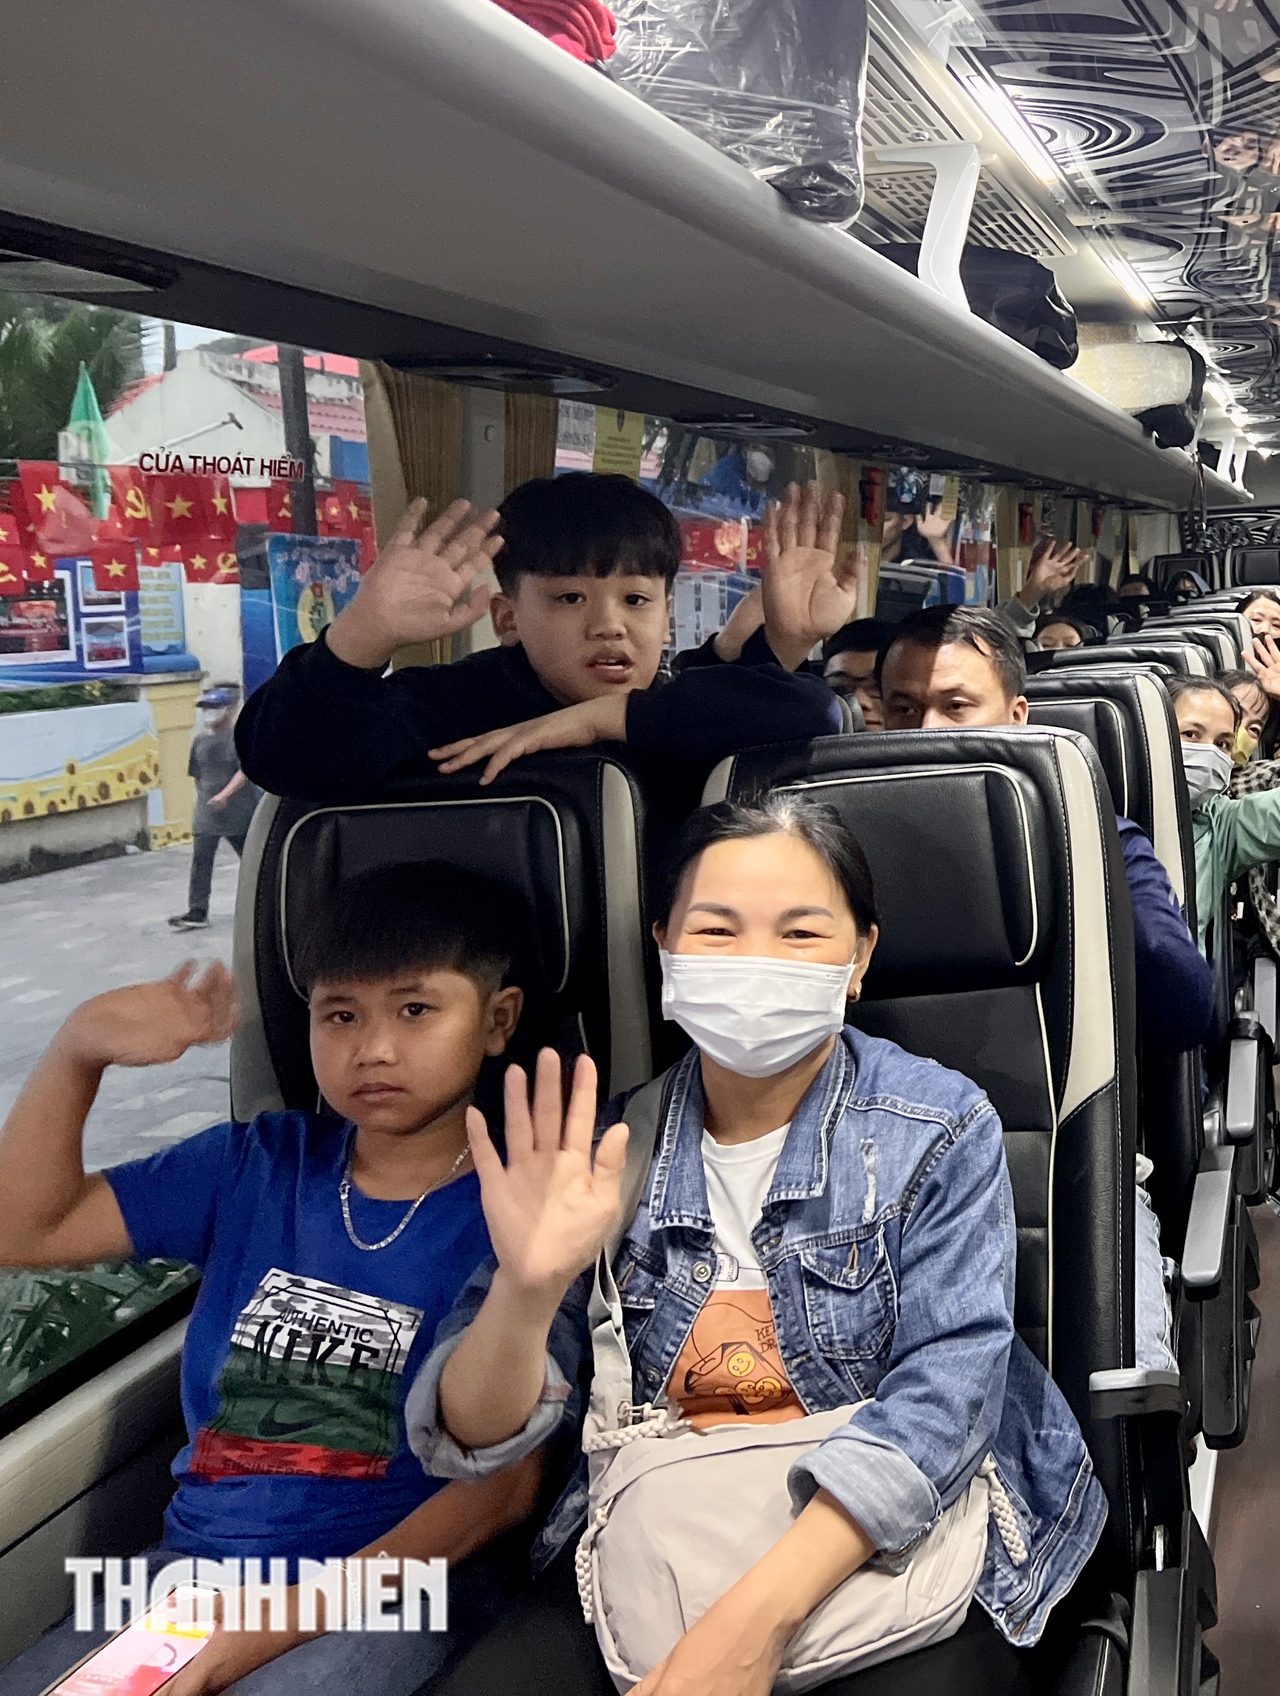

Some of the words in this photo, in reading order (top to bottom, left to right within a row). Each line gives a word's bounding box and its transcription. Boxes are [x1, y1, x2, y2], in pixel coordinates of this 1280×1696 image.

[138, 446, 184, 473] CỬA
[188, 451, 255, 476] THOÁT
[259, 453, 305, 480] HIỂM
[275, 1307, 374, 1344] AUTHENTIC
[253, 1320, 380, 1390] NIKE
